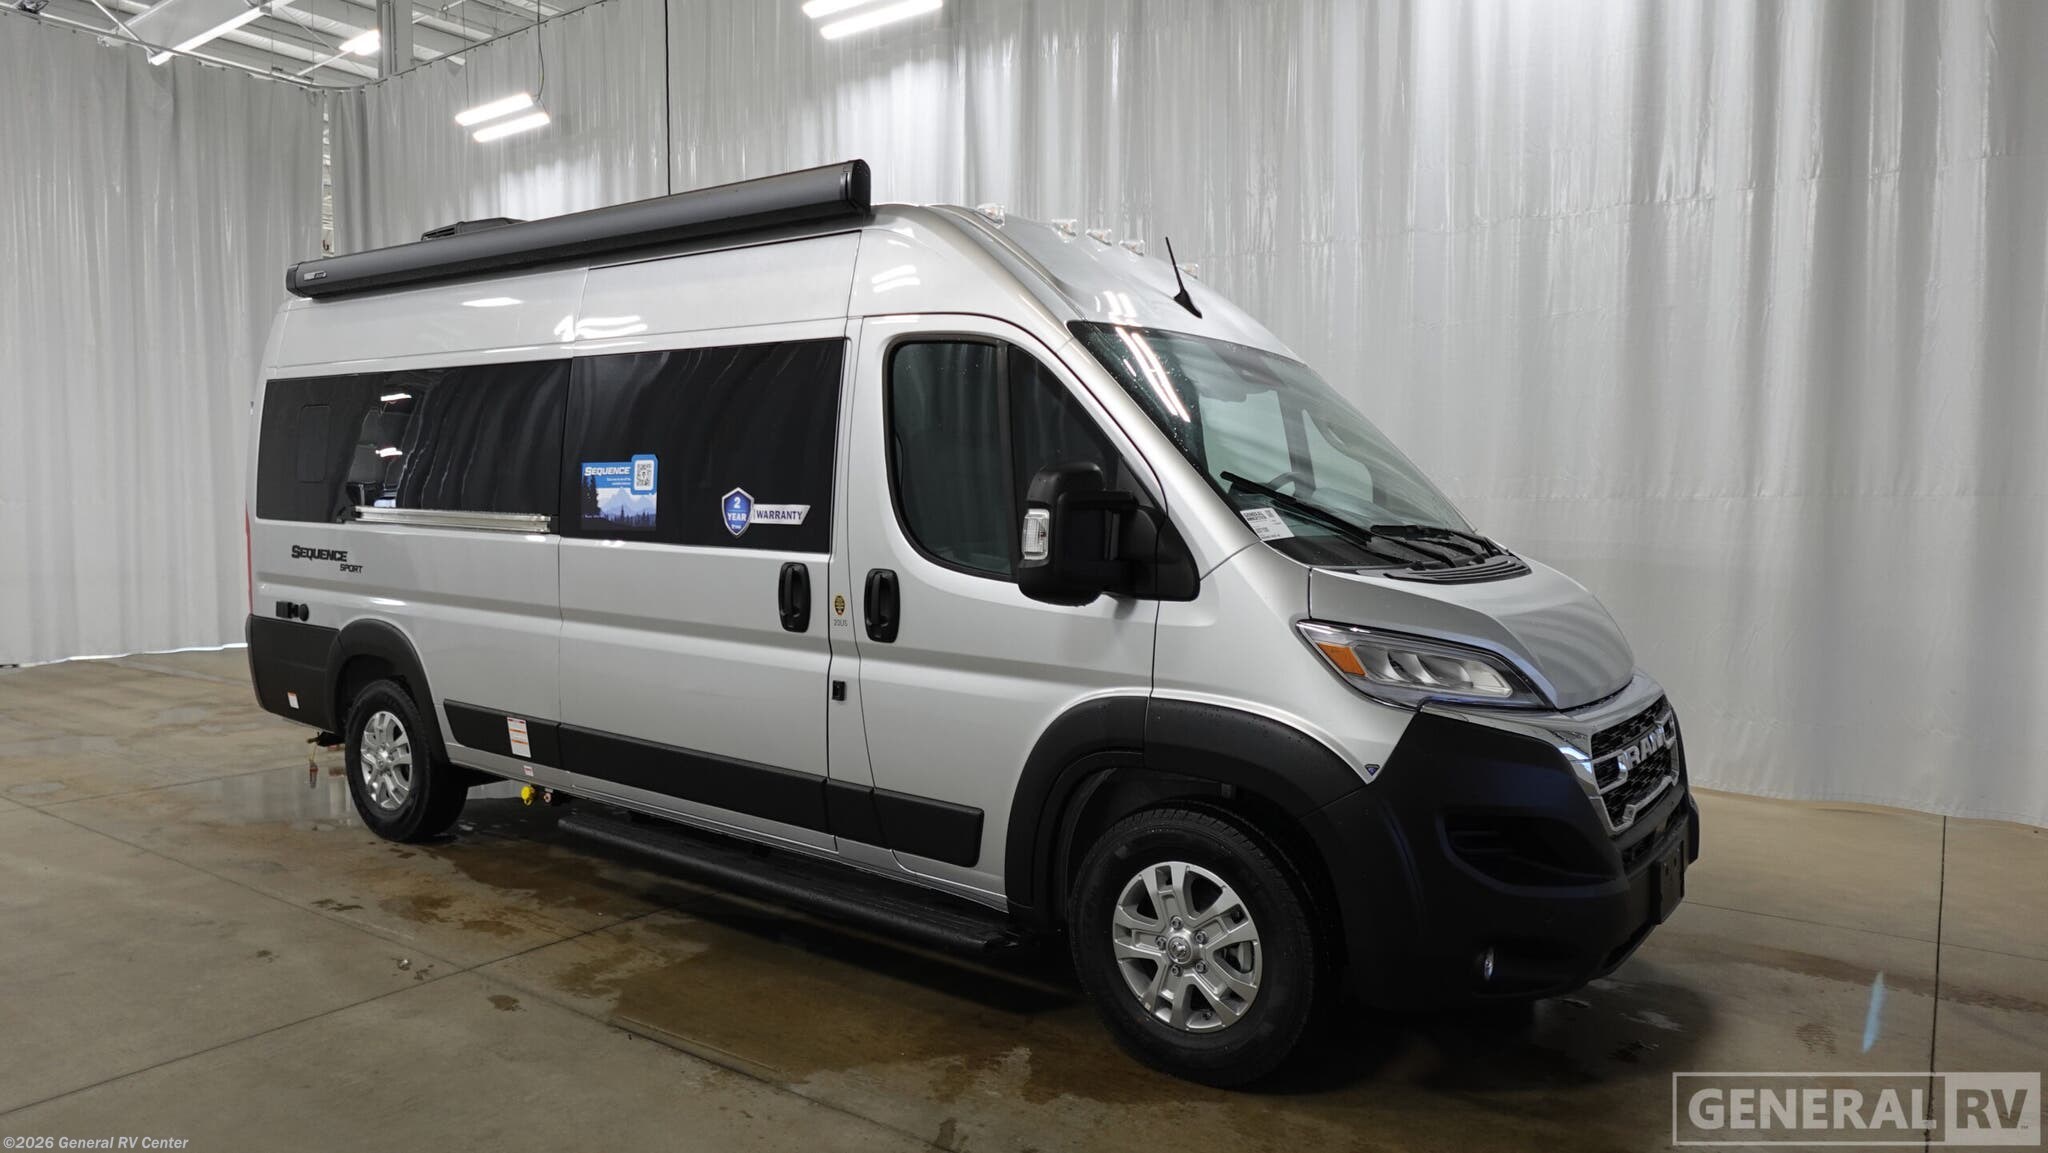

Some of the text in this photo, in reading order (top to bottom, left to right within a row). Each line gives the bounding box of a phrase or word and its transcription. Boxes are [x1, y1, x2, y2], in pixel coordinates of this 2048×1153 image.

[584, 466, 631, 476] SEQUENCE
[733, 496, 741, 509] 2
[727, 512, 747, 521] YEAR
[756, 509, 803, 520] WARRANTY
[291, 544, 348, 562] SEQUENCE
[340, 563, 363, 573] SPORT
[1618, 725, 1665, 772] RAM
